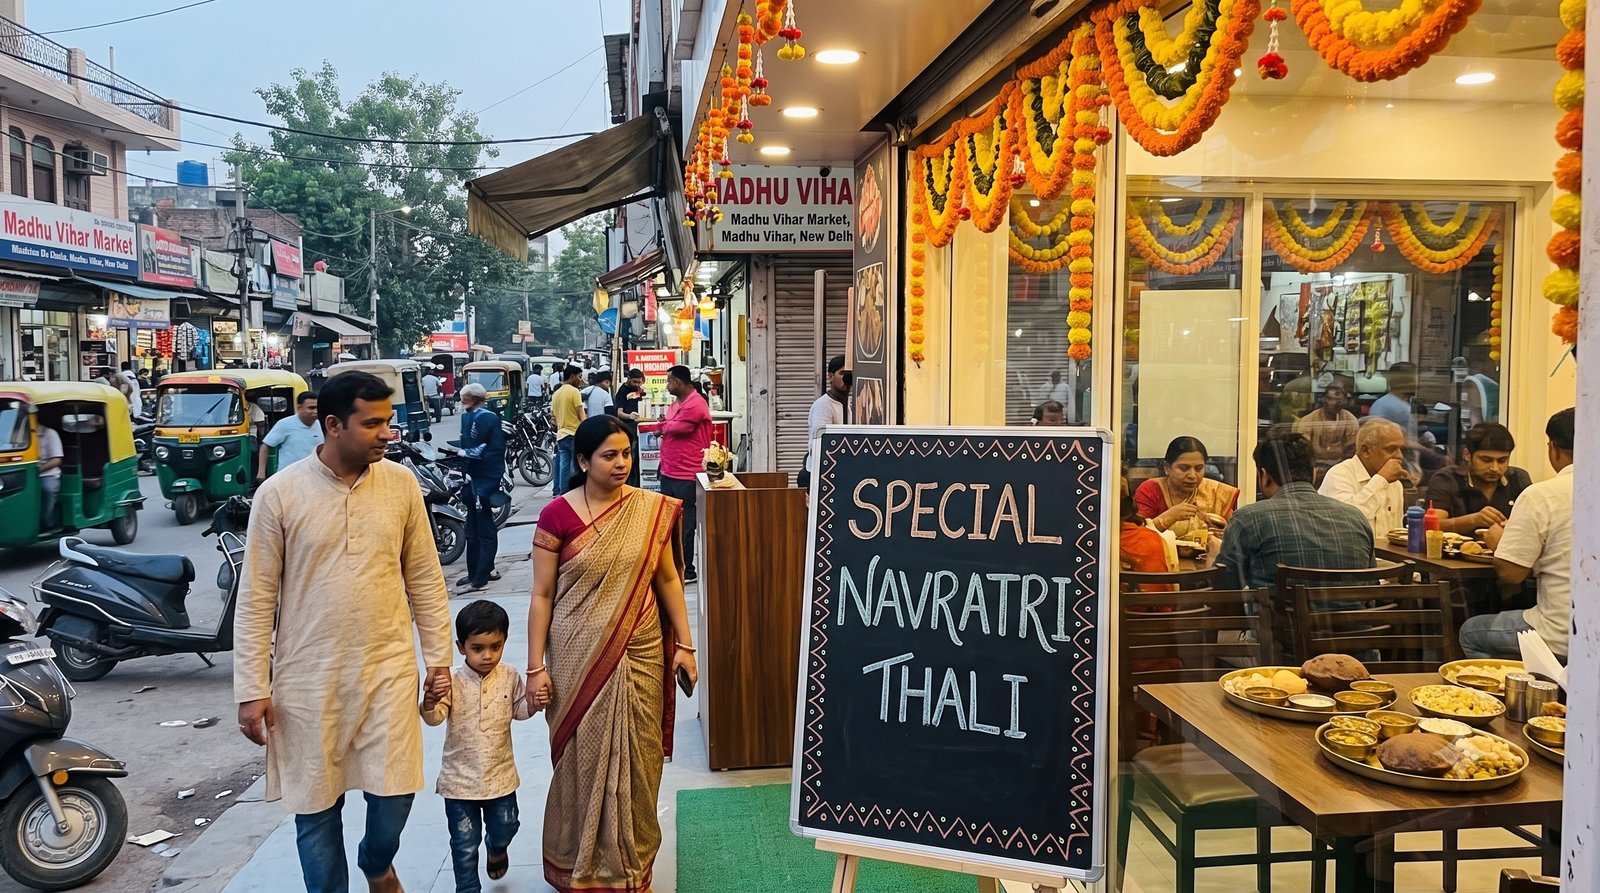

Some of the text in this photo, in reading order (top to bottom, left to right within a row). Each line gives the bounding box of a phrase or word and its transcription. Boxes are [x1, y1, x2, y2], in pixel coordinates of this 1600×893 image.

[703, 177, 853, 205] MADHU VIHA
[4, 210, 52, 241] Madhu
[56, 221, 90, 247] Vihar
[94, 229, 134, 255] Market
[722, 230, 853, 244] Madhu Vihar, New Delh
[731, 213, 850, 227] Madhu Vihar Market,
[848, 478, 1063, 545] SPECIAL
[837, 554, 1072, 653] NAVRATRI
[862, 652, 1028, 739] THALI
